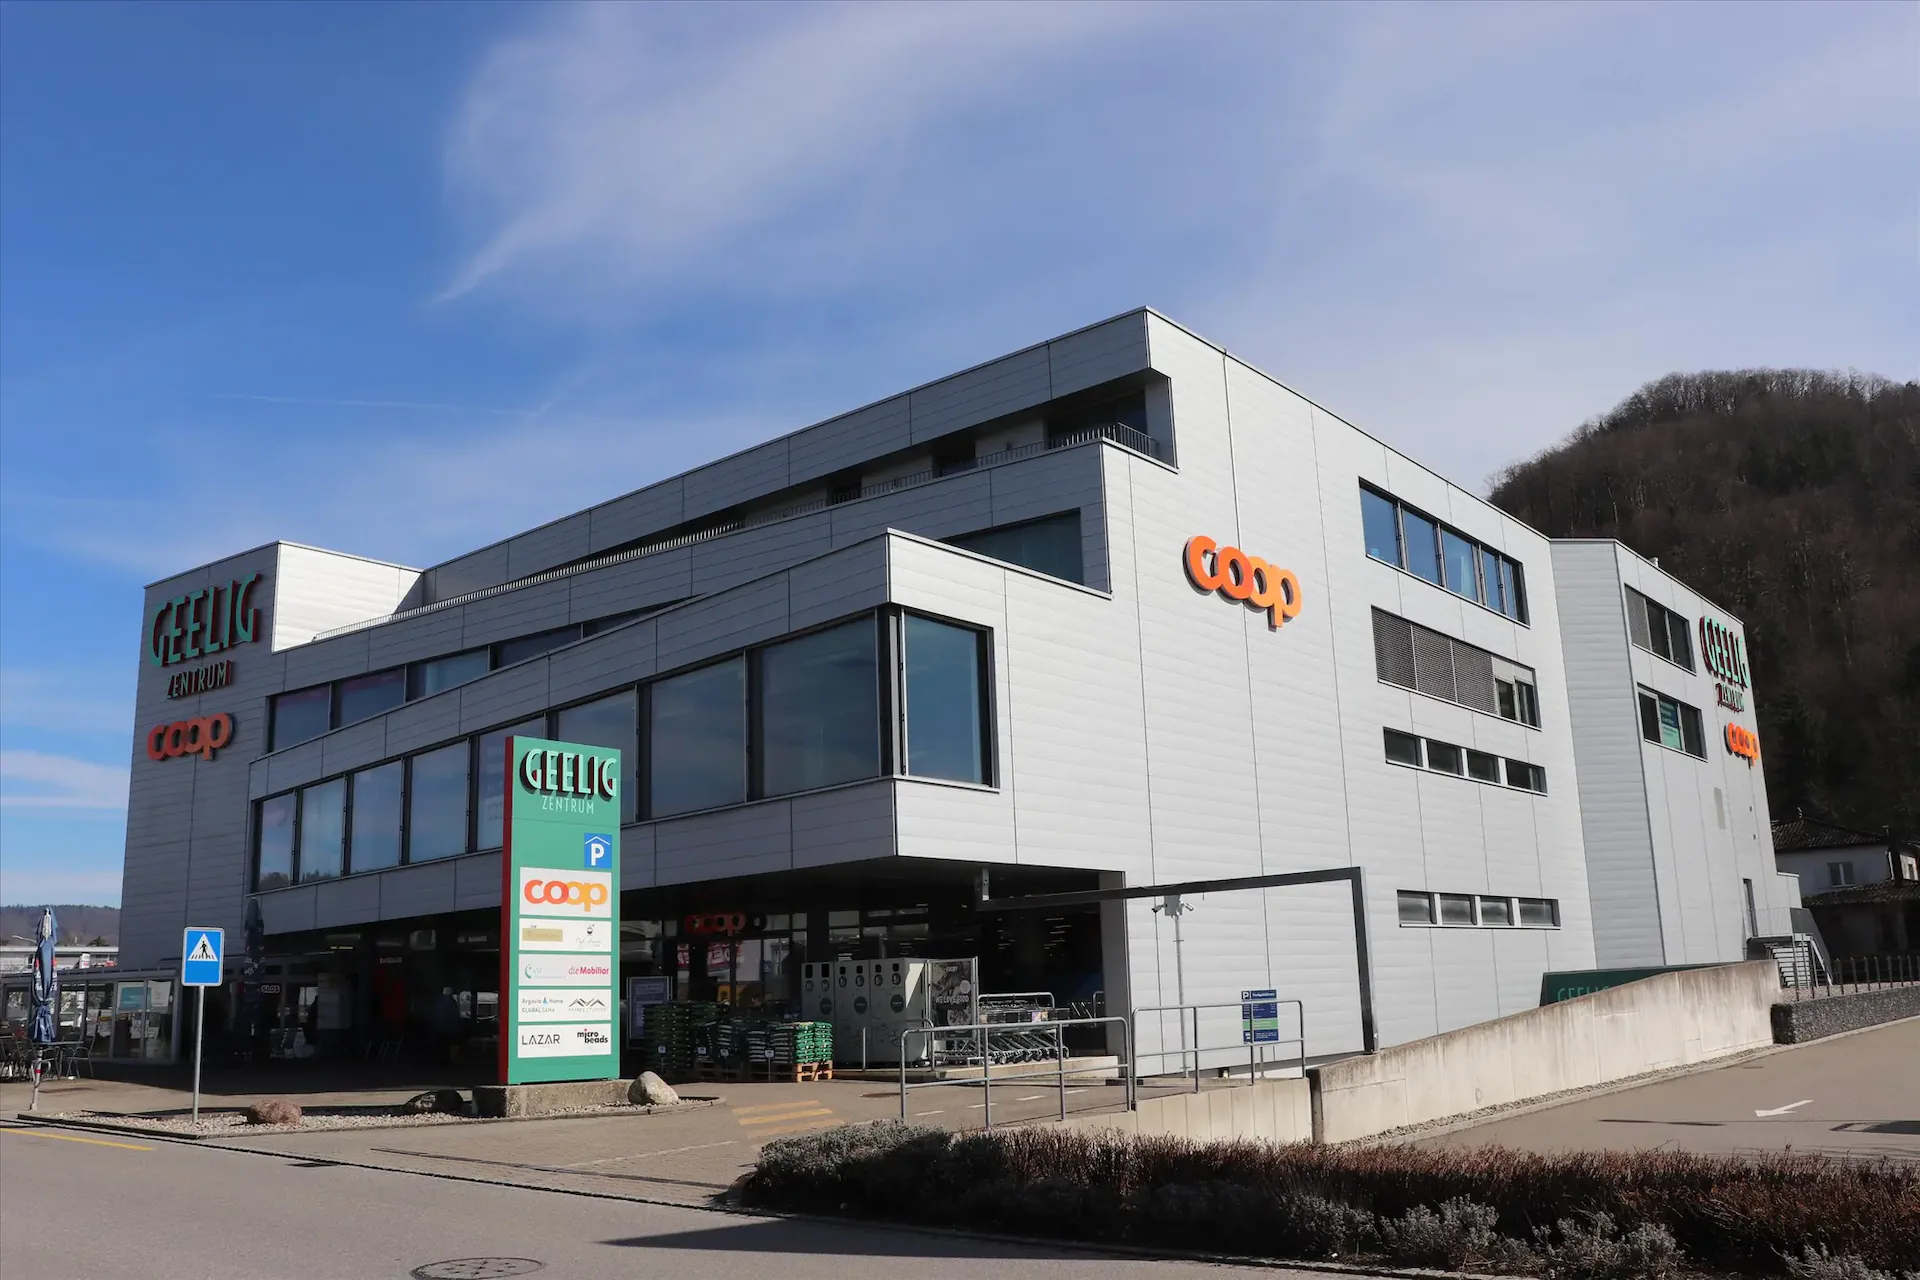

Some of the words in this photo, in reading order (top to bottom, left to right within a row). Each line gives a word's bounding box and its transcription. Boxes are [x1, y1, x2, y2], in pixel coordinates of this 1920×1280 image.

[1184, 535, 1303, 630] coop
[150, 573, 260, 667] GEELIG
[1700, 615, 1750, 690] GEELIG
[167, 660, 231, 699] ZENTRUM
[147, 712, 235, 761] coop
[1725, 722, 1759, 768] coop
[521, 749, 617, 798] GEELIG
[541, 795, 594, 814] ZENTRUM
[590, 843, 605, 866] P
[524, 880, 608, 912] coop
[685, 913, 746, 937] coop
[521, 1034, 561, 1046] LAZAR
[577, 1028, 599, 1038] micro
[584, 1035, 609, 1044] beads
